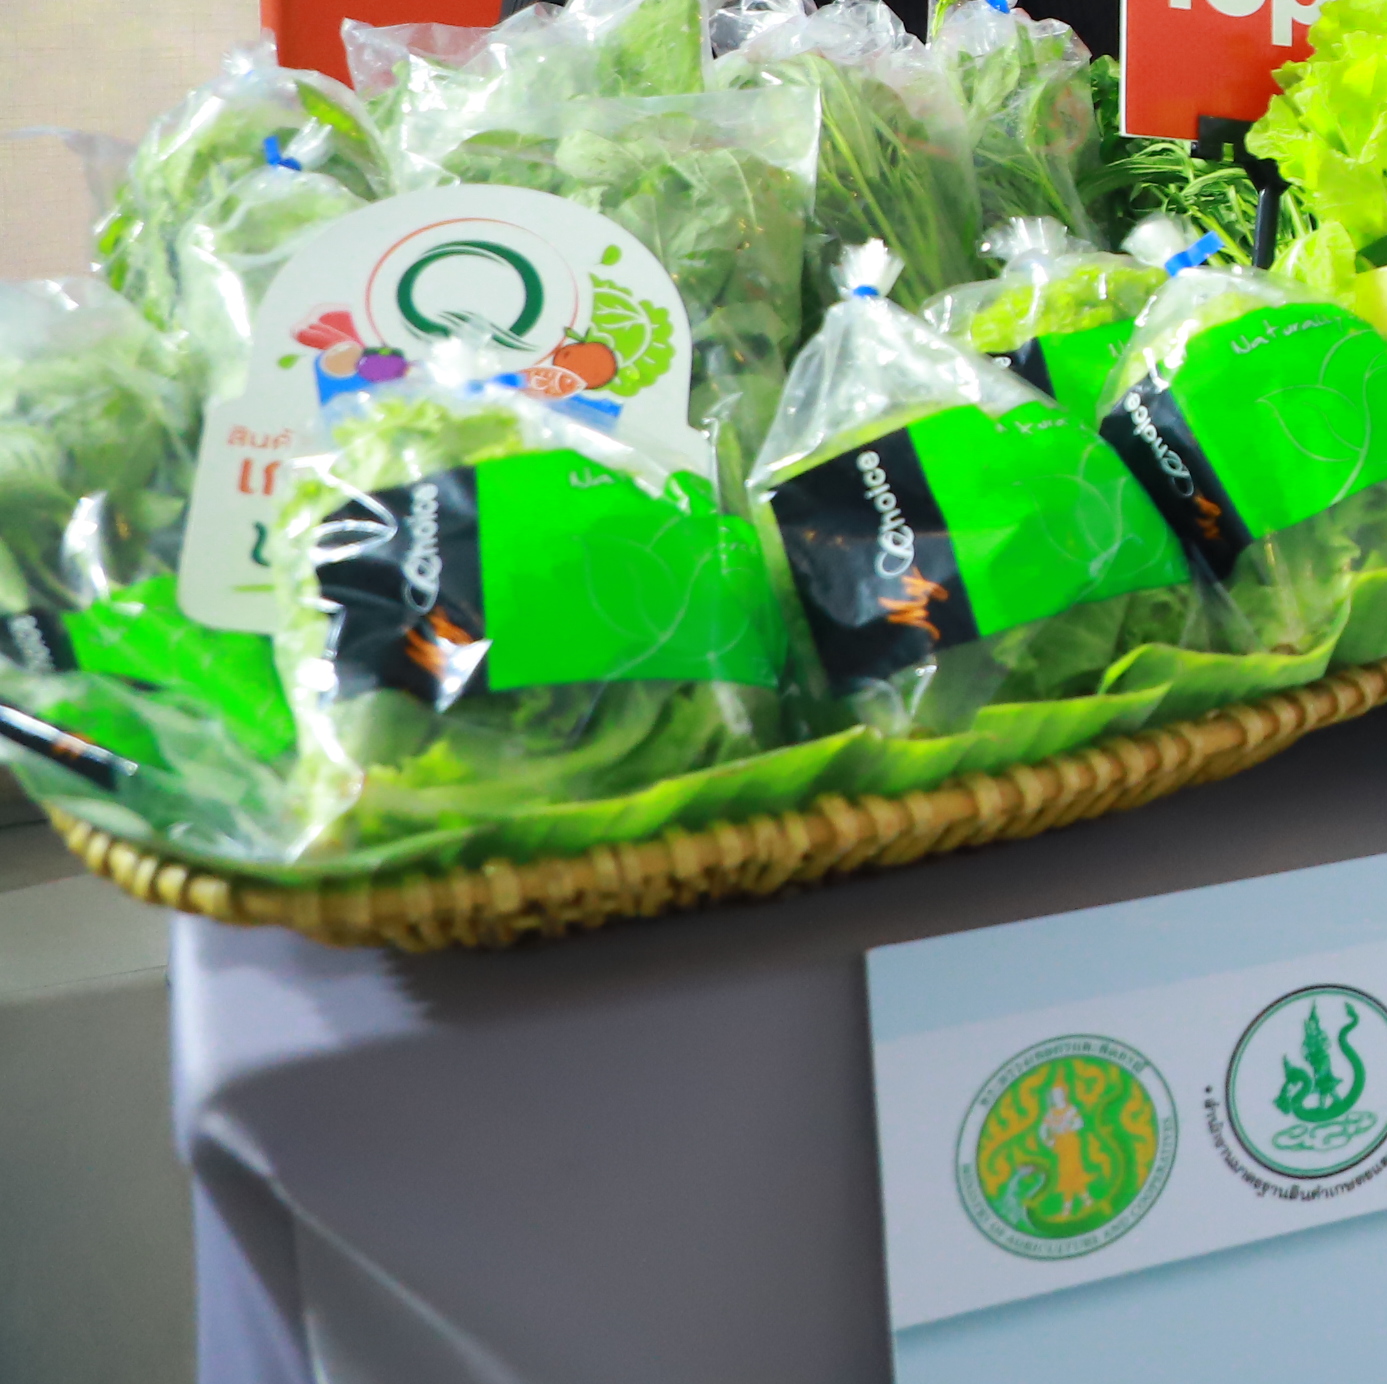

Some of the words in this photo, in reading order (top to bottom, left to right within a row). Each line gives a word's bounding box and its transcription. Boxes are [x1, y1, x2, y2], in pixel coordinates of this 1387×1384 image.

[1123, 391, 1195, 499] Choice
[401, 482, 443, 616] Choice
[855, 450, 916, 580] Choice
[878, 563, 949, 641] My
